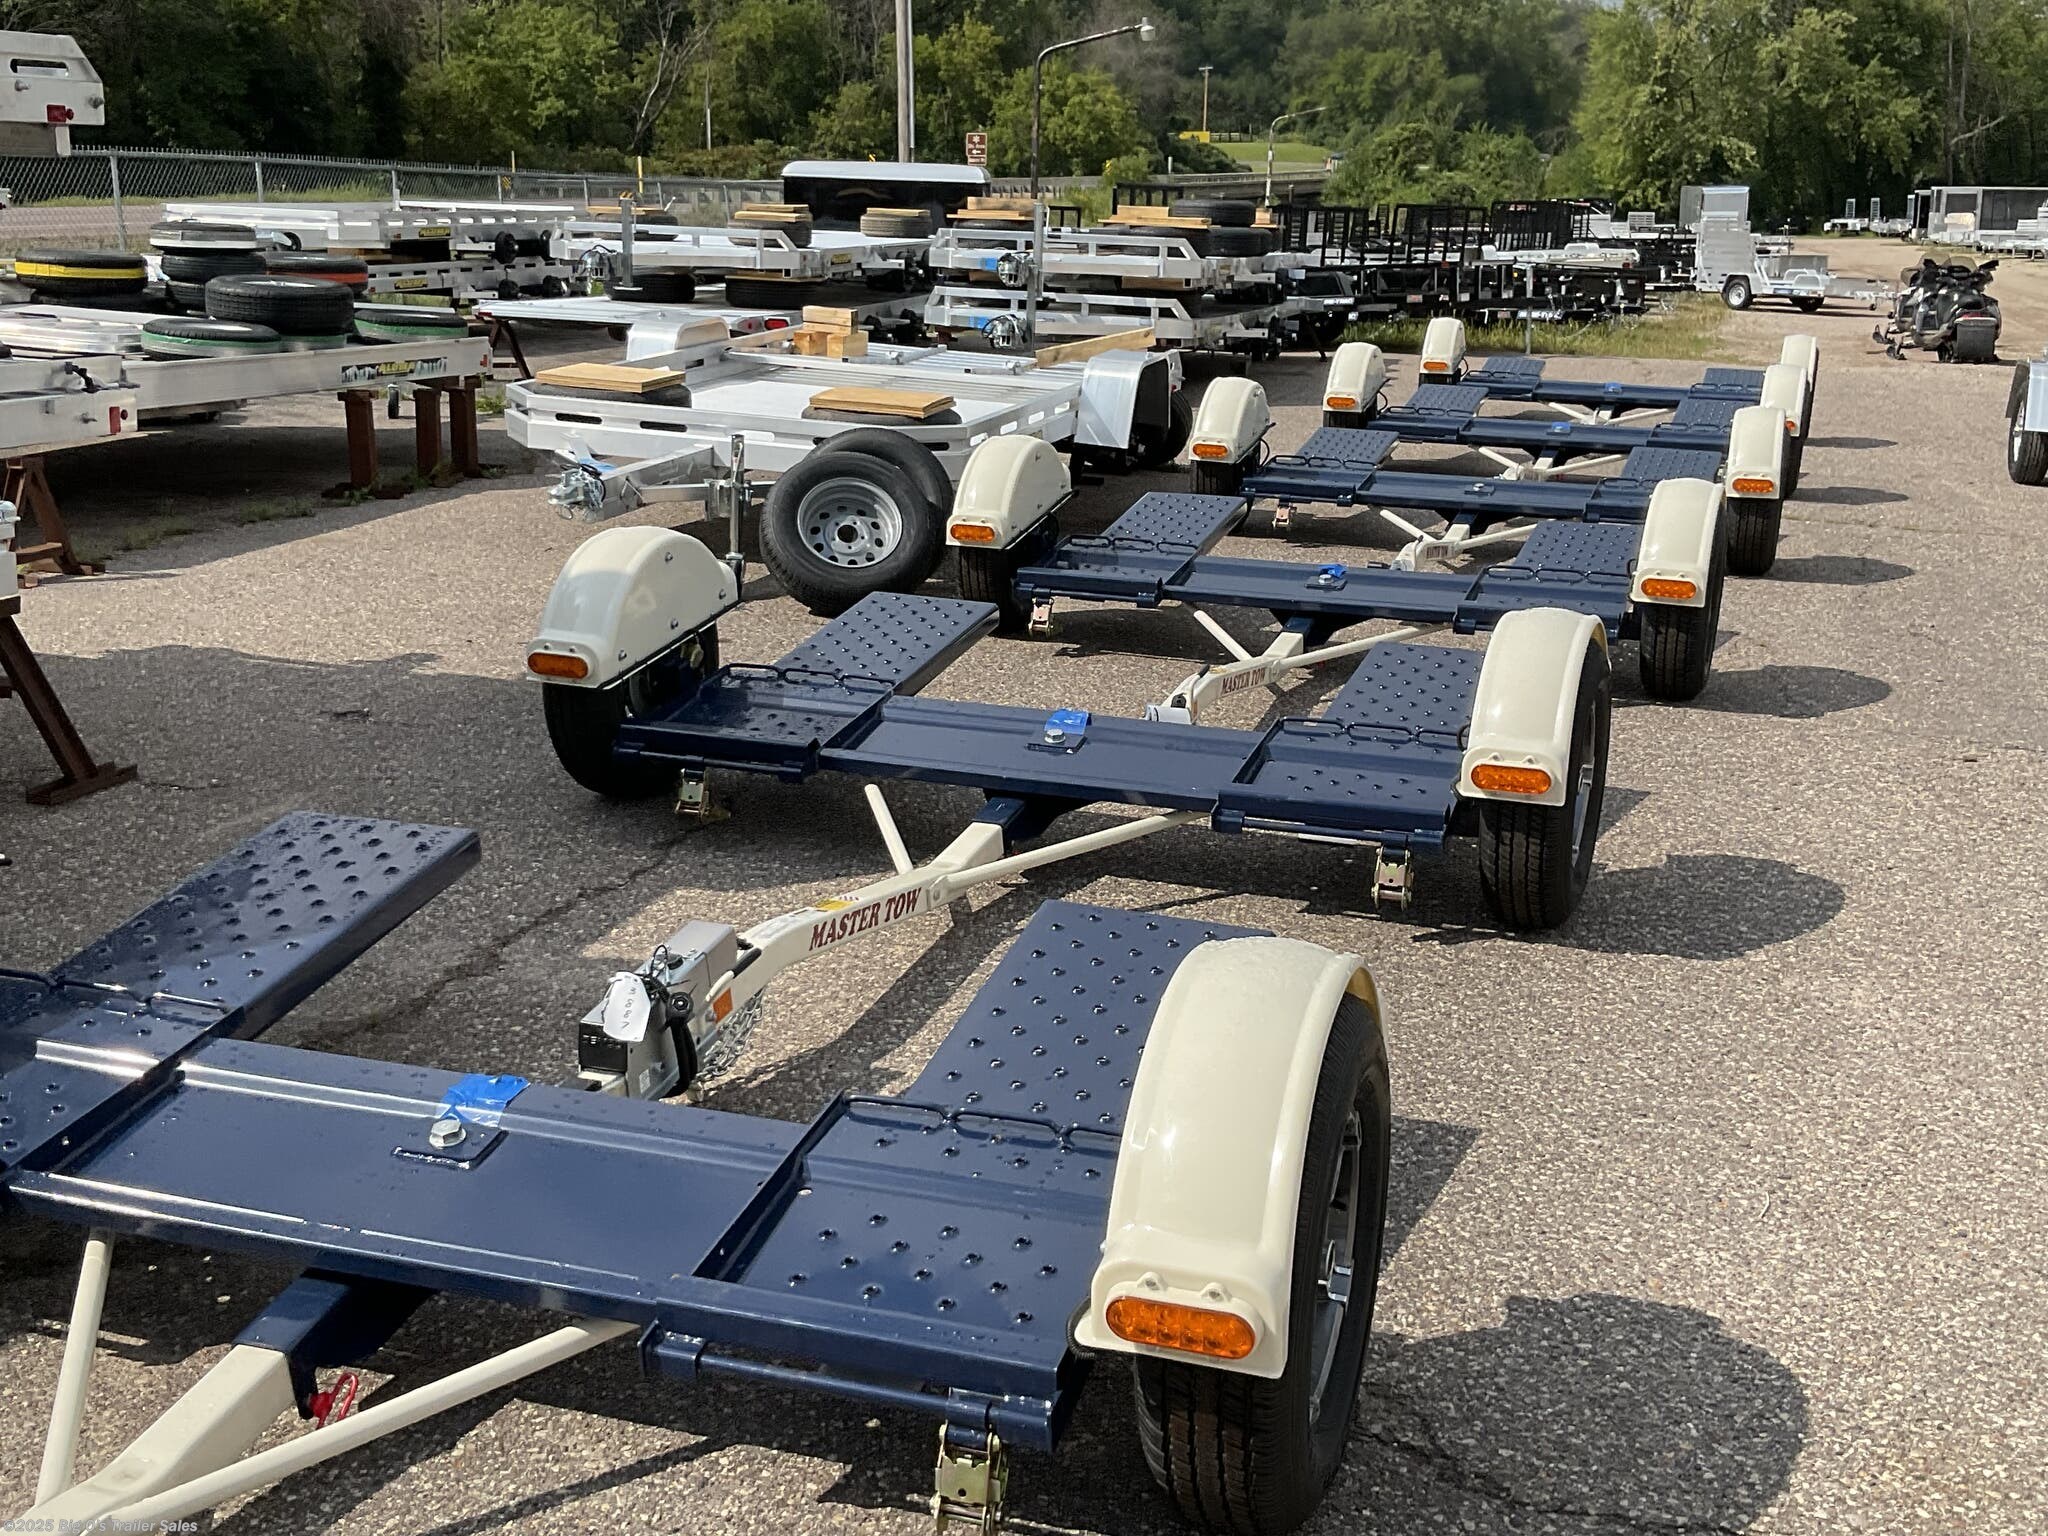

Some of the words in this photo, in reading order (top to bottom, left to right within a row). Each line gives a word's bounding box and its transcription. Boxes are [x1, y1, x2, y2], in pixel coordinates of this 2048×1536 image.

[1221, 672, 1250, 696] MASTER
[1250, 667, 1266, 687] TOW
[809, 901, 881, 951] MASTER
[884, 887, 922, 923] TOW
